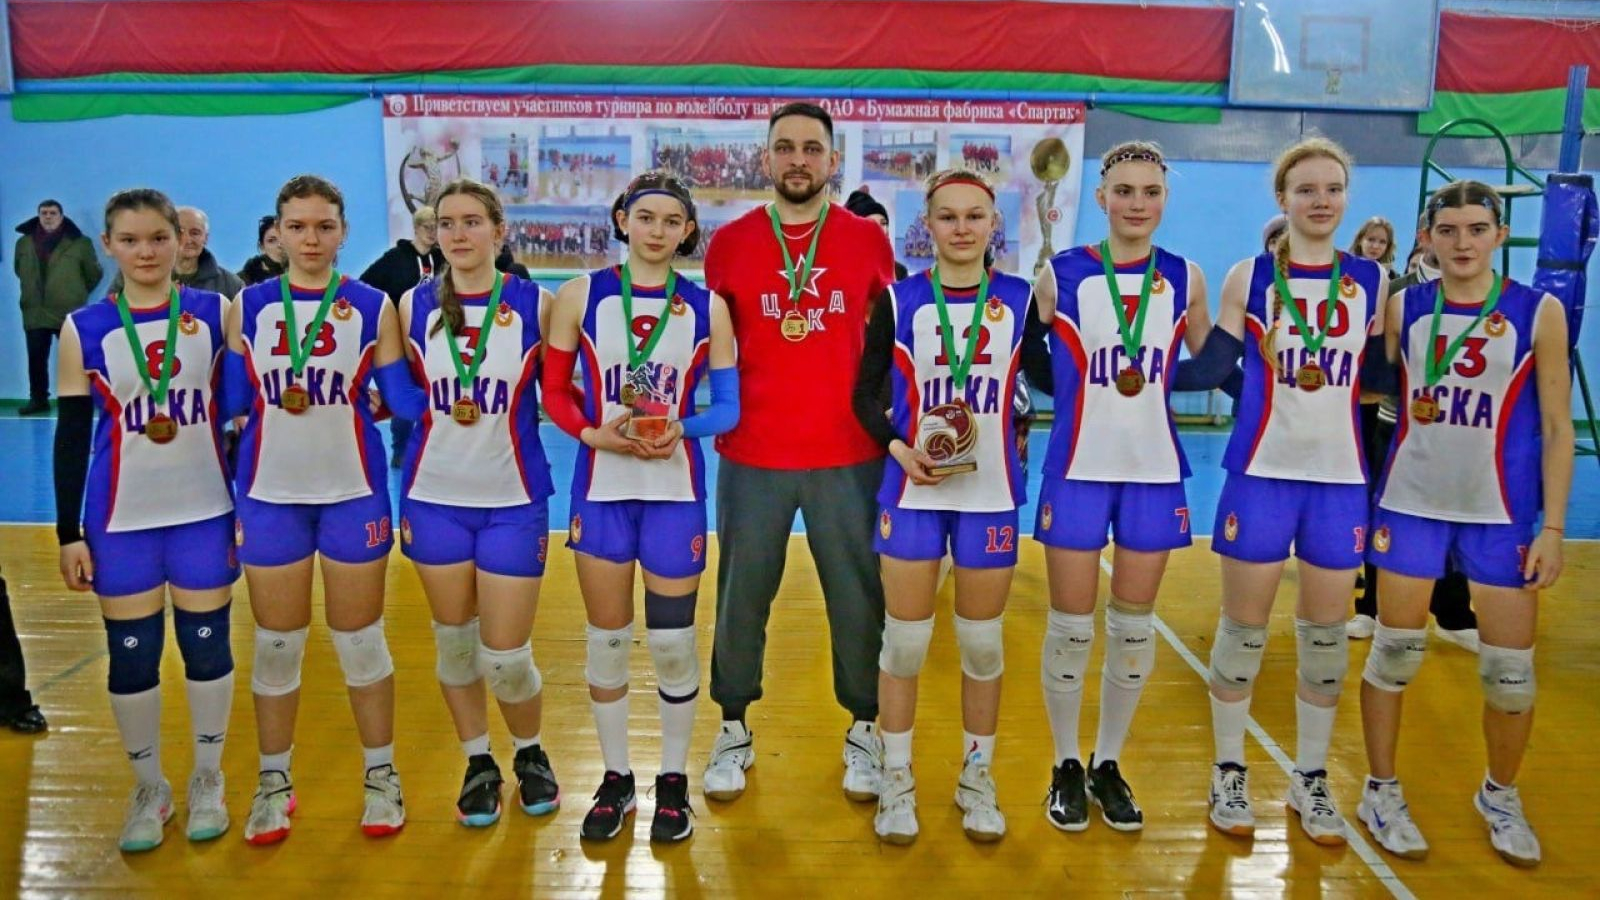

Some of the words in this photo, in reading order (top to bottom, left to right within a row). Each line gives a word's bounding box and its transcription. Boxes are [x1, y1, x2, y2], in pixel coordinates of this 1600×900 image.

[413, 95, 510, 116] Приветствуем
[513, 99, 593, 117] участников
[596, 100, 652, 118] турнира
[655, 102, 674, 114] по
[675, 97, 749, 119] волейболу
[752, 102, 769, 115] на
[820, 99, 854, 116] ОАО
[943, 100, 1005, 123] фабрика
[761, 290, 845, 332] ЦКА
[1288, 297, 1350, 338] 10
[270, 320, 338, 357] 18
[630, 314, 660, 352] 9
[934, 323, 992, 366] 12
[144, 339, 183, 381] 8
[365, 516, 390, 548] 18
[985, 525, 1014, 553] 12
[1174, 507, 1189, 534] 7
[690, 534, 704, 562] 9
